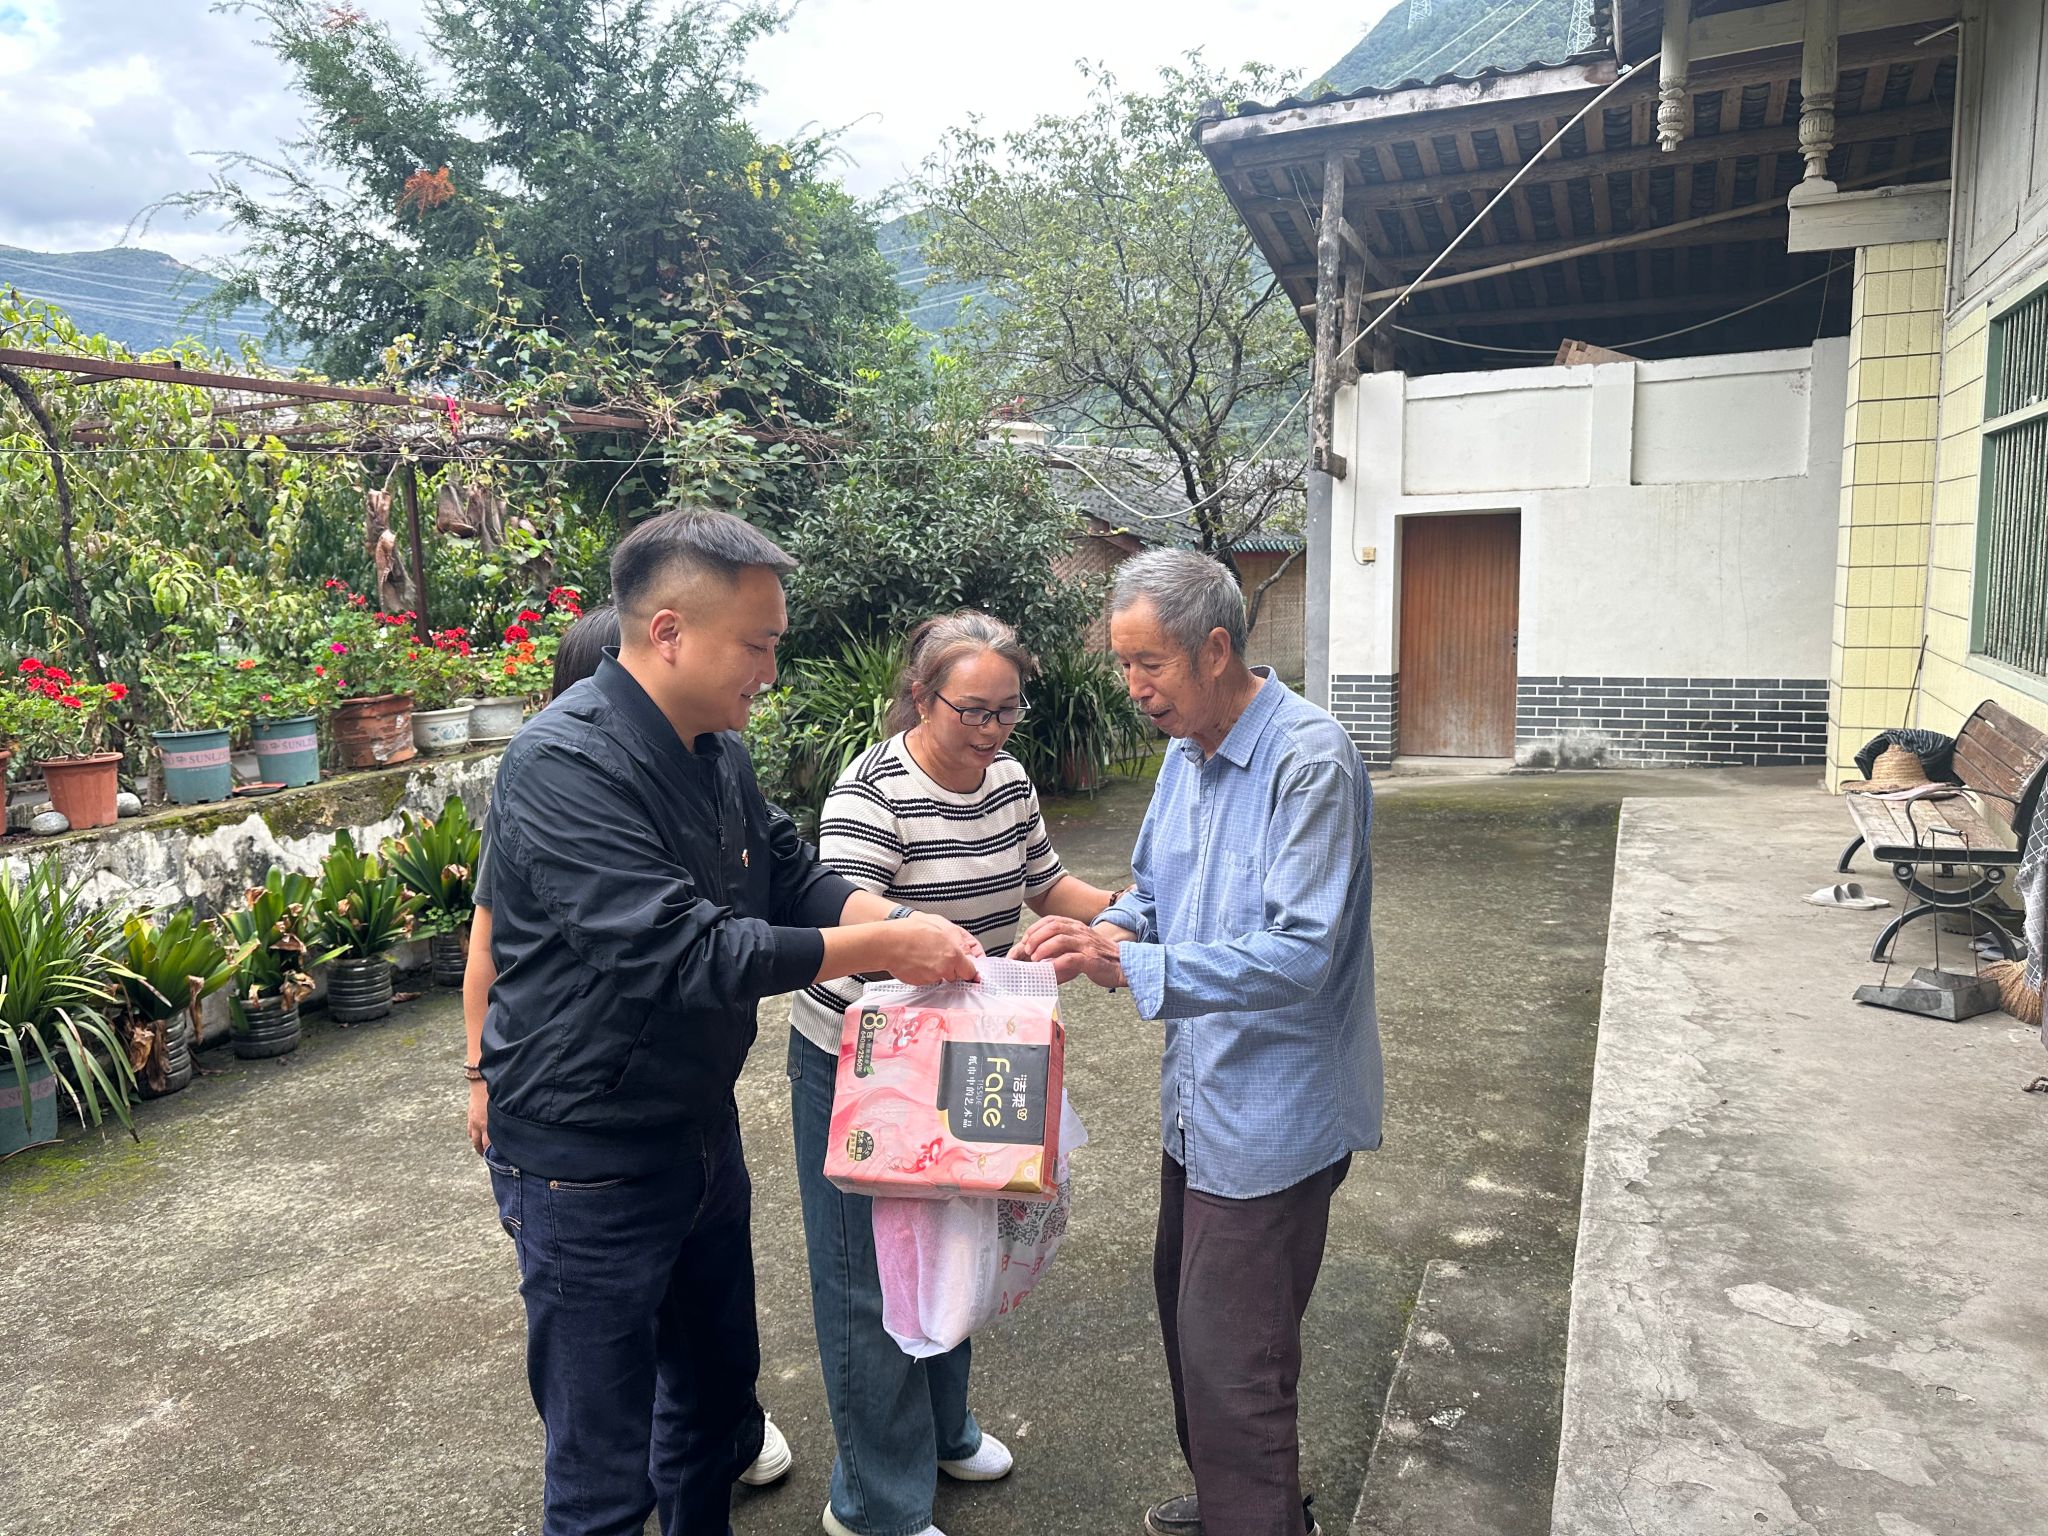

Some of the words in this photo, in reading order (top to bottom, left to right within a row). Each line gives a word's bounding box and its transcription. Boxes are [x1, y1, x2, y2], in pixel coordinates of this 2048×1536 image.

[862, 1013, 887, 1029] 8
[962, 1055, 978, 1129] 纸巾中的艺术品
[976, 1079, 984, 1106] TISSUE
[982, 1057, 1011, 1128] Face
[1012, 1074, 1028, 1108] 洁柔
